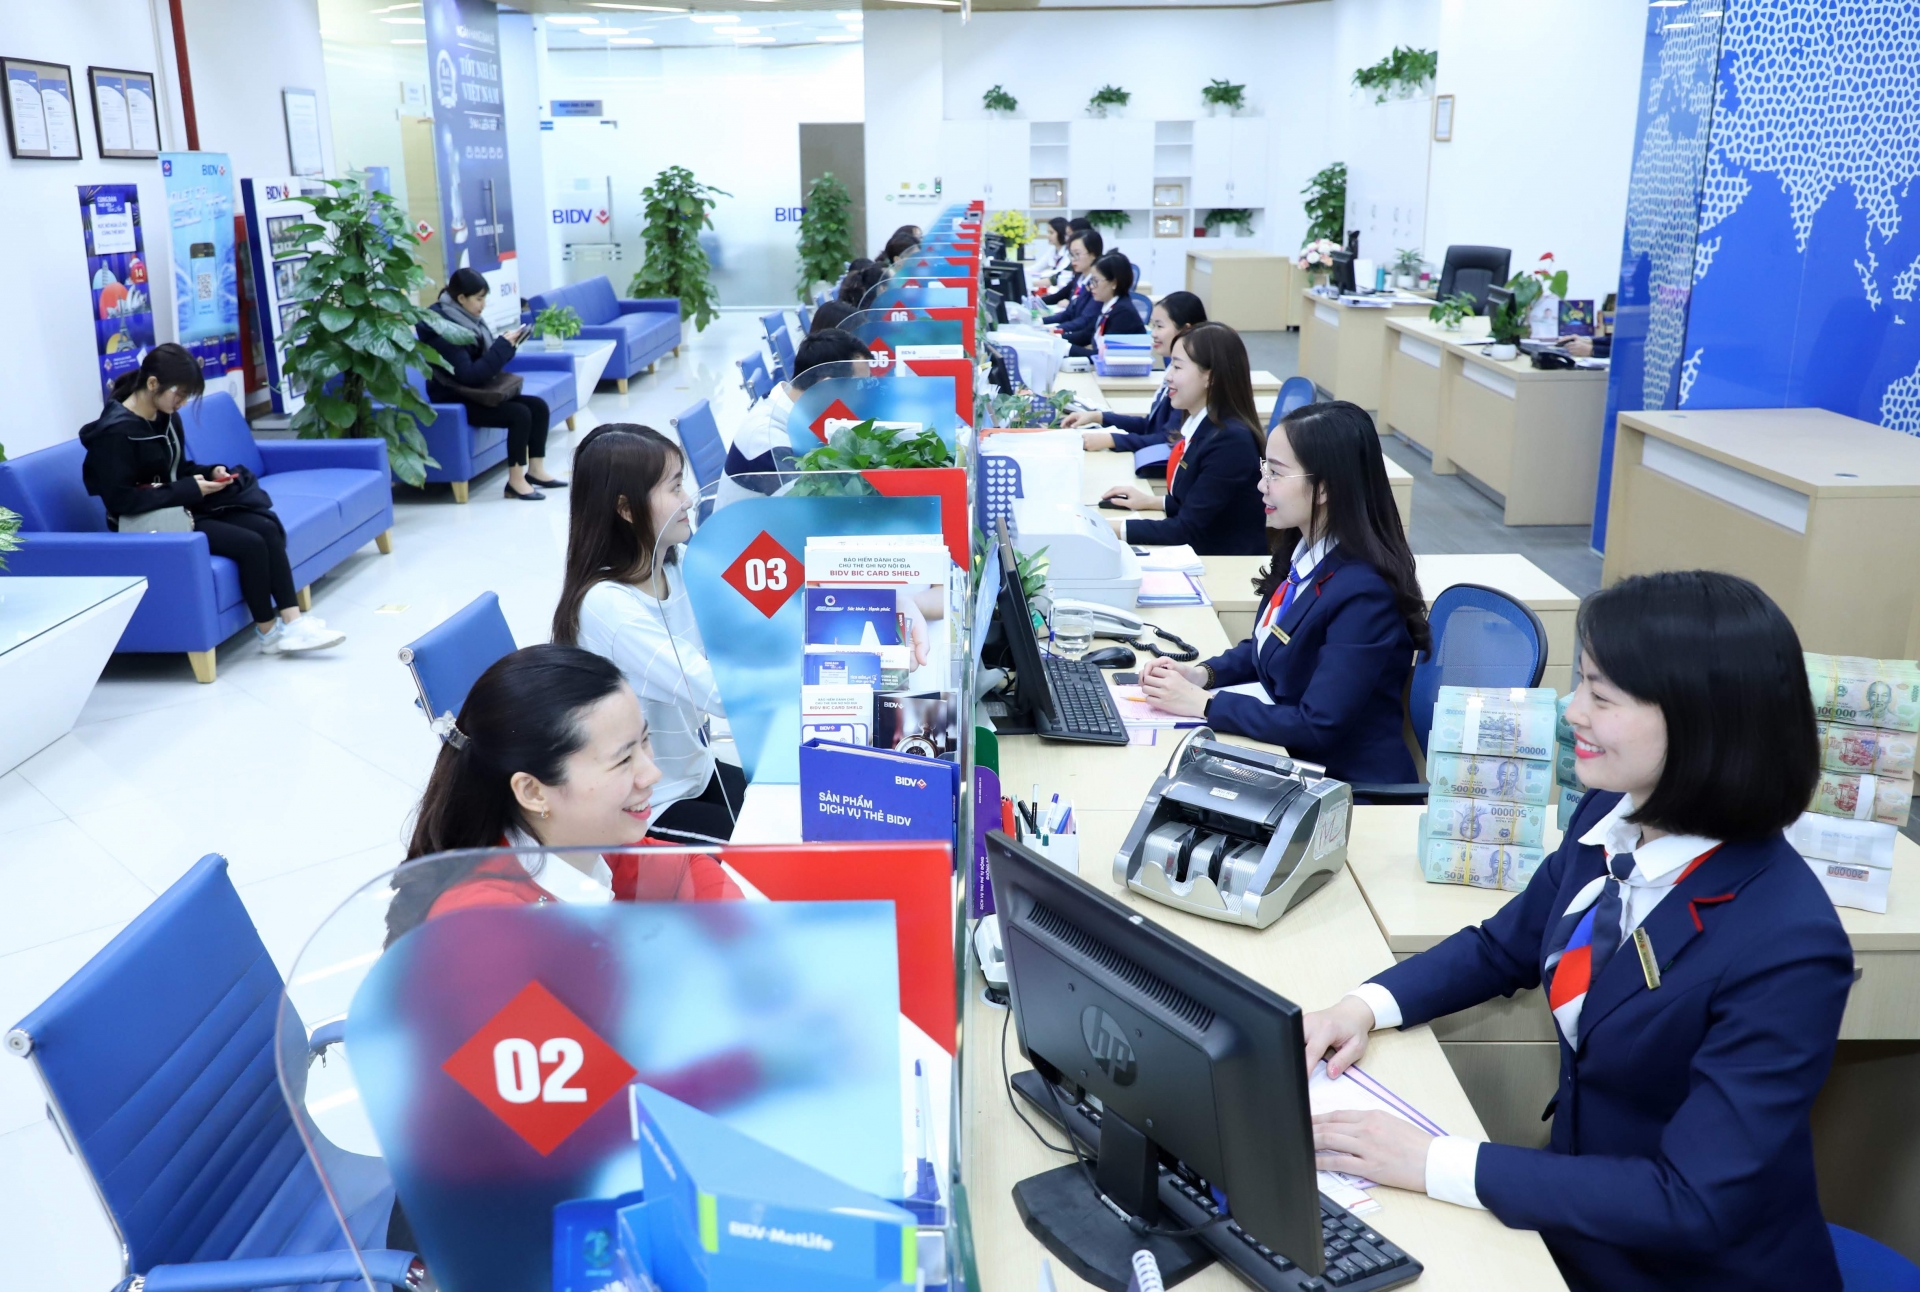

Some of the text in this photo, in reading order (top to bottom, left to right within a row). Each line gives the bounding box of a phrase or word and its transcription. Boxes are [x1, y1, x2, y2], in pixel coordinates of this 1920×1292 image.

[202, 164, 218, 176] BIDV
[266, 186, 281, 200] BIDV
[552, 209, 593, 224] BIDV
[775, 207, 807, 221] BID
[745, 557, 788, 592] 03
[883, 701, 898, 709] BIDV
[1816, 706, 1857, 719] 100000
[1515, 746, 1546, 756] 500000
[895, 776, 917, 788] BIDV
[818, 790, 873, 809] SẢN PHẨM
[819, 802, 912, 827] DỊCH VỤ THẺ BIDV
[1491, 807, 1527, 818] 500000
[1828, 865, 1864, 879] 200000
[1090, 1006, 1131, 1080] hp
[493, 1037, 588, 1104] 02
